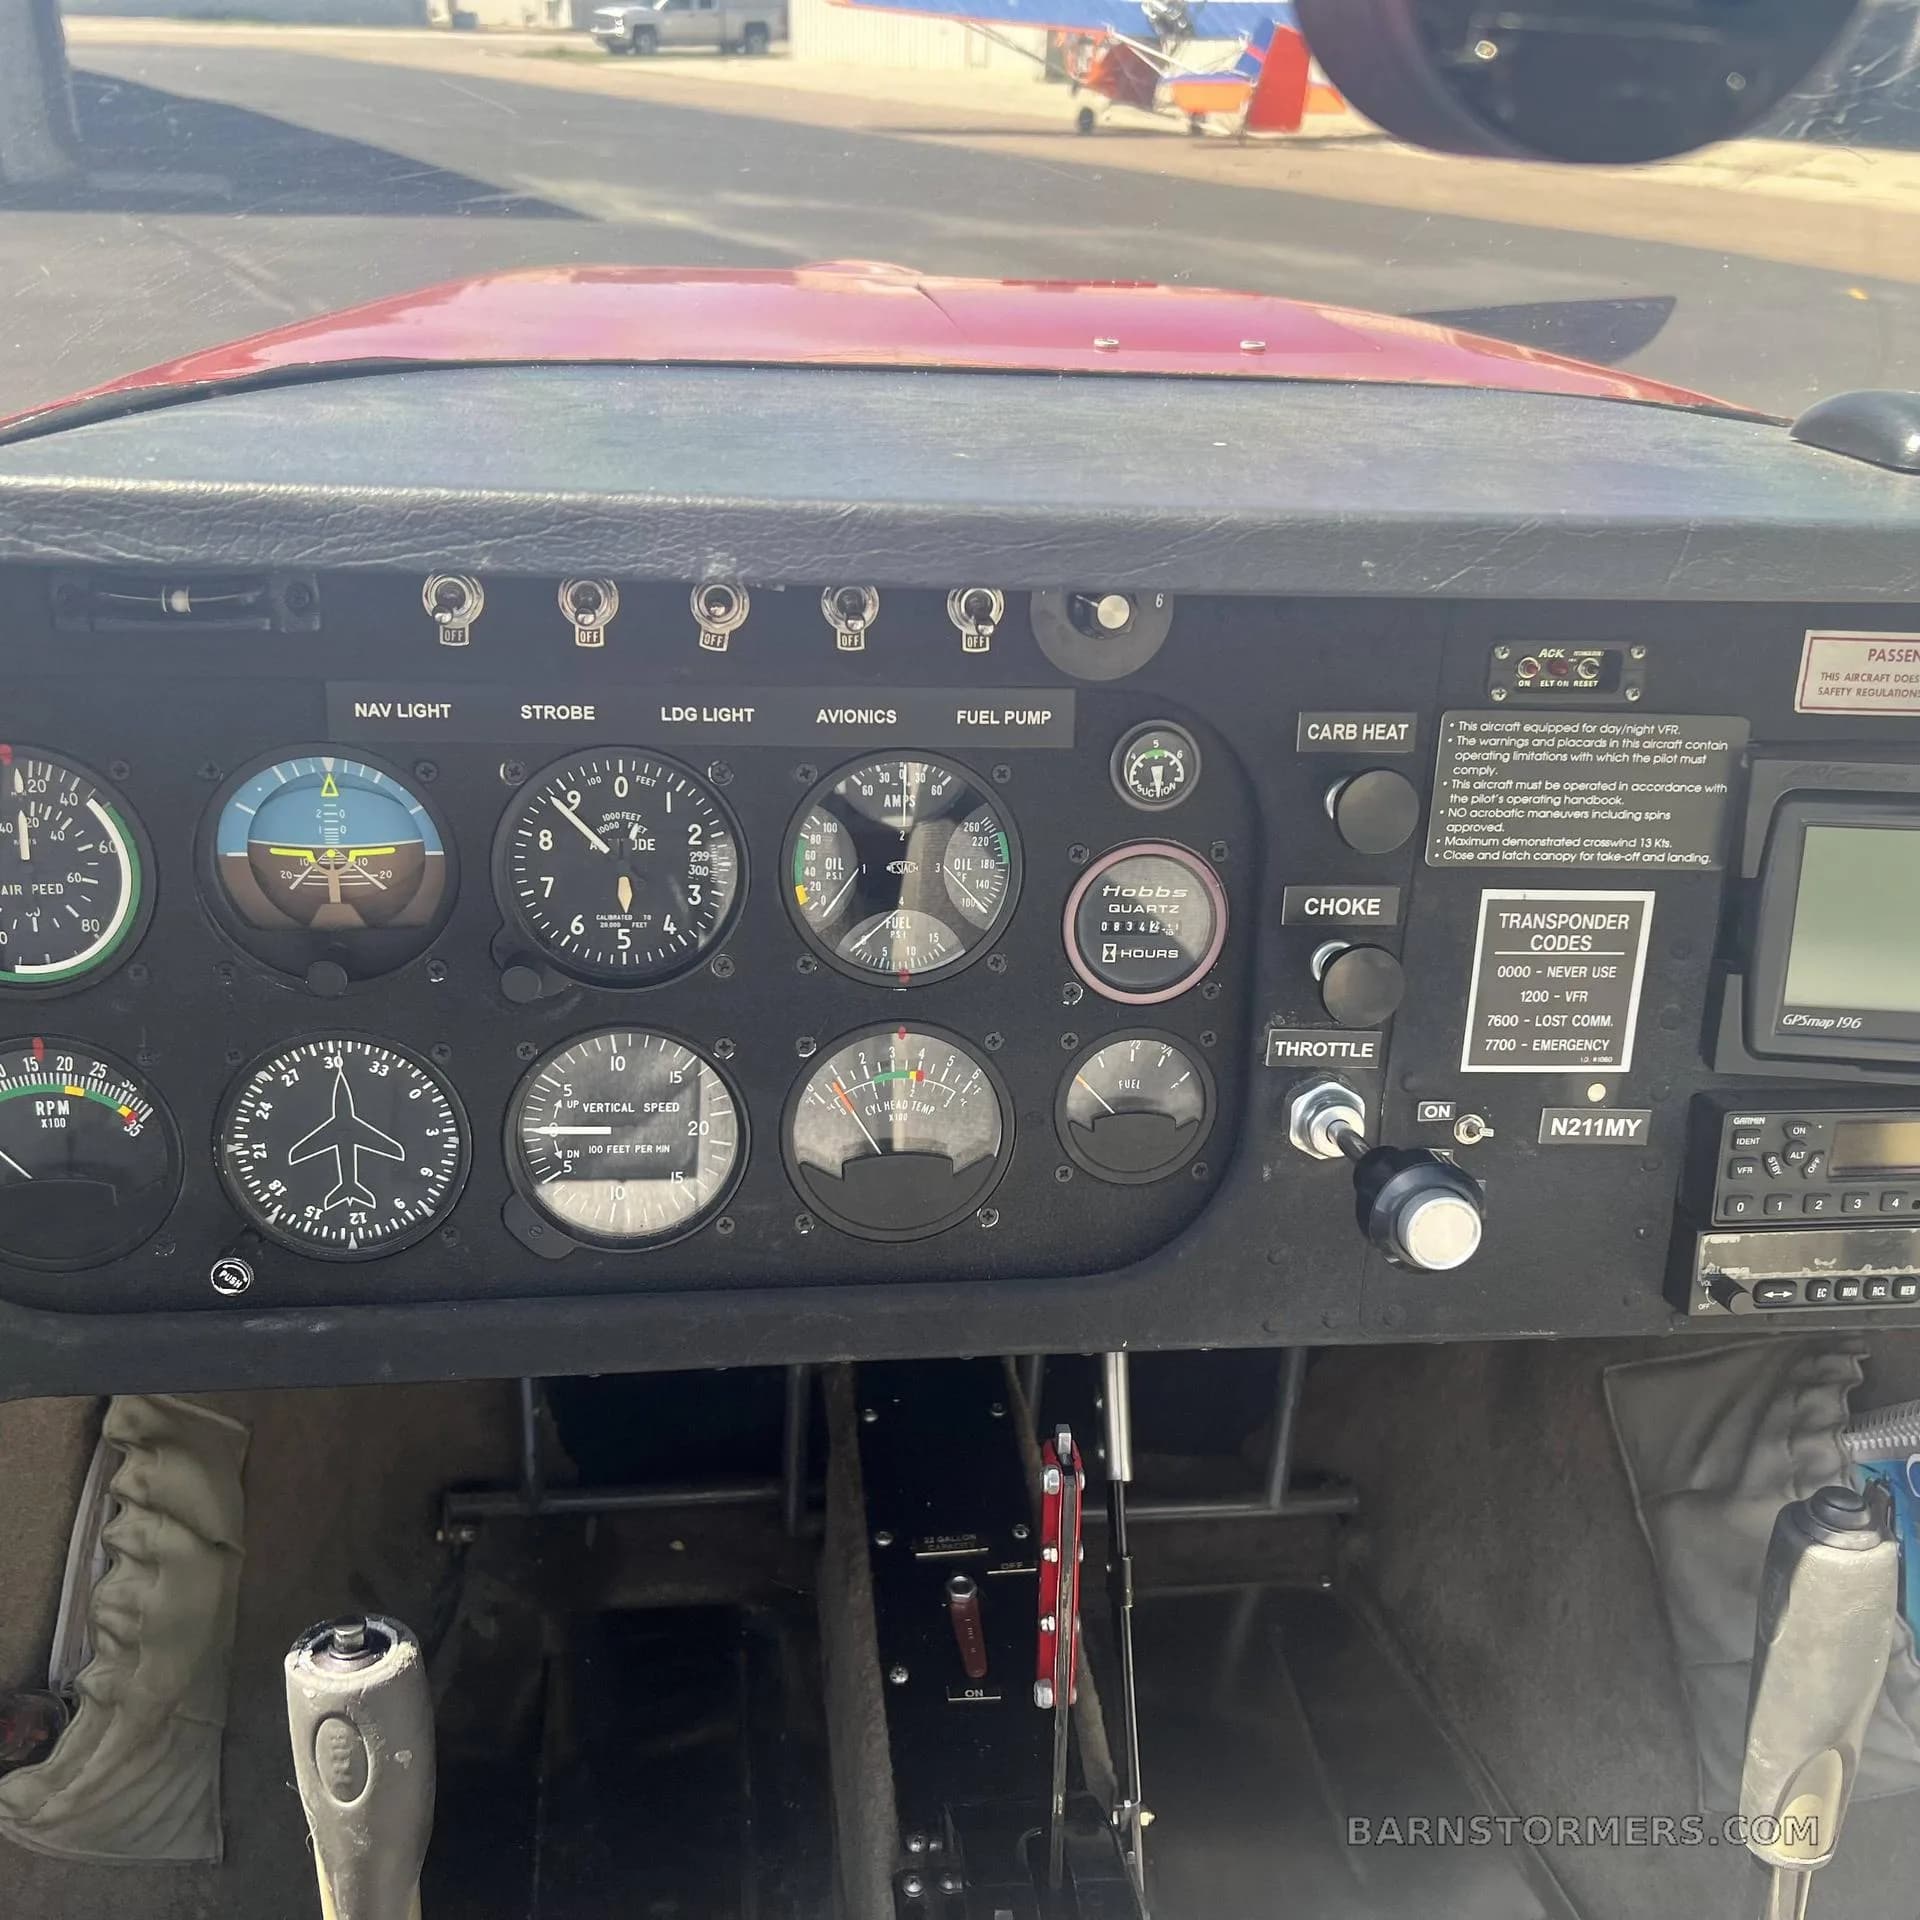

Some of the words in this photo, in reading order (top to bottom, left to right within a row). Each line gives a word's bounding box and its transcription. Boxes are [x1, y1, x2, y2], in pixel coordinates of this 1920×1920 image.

[443, 629, 465, 642] OFF
[579, 630, 600, 643] OFF
[703, 633, 724, 647] OFF
[841, 634, 860, 647] OFF
[967, 635, 985, 648] OFF
[1538, 648, 1565, 658] ACK
[1820, 672, 1840, 681] THIS
[1844, 673, 1890, 682] AIRCRAFT
[1894, 674, 1920, 683] DOES
[1818, 687, 1852, 696] SAFETY
[355, 703, 391, 717] NAV
[398, 703, 451, 718] LIGHT
[521, 705, 595, 720] STROBE
[661, 706, 697, 721] LDG
[703, 708, 754, 722] LIGHT
[816, 709, 897, 725] AVIONICS
[957, 710, 1000, 724] FUEL
[1004, 710, 1052, 725] PUMP
[1307, 723, 1358, 740] CARB
[1362, 723, 1409, 740] HEAT
[1458, 721, 1478, 731] This
[1480, 722, 1521, 732] aircraft
[1523, 722, 1579, 734] equipped
[1582, 723, 1597, 733] for
[1600, 723, 1655, 736] day/night
[1456, 735, 1476, 746] The
[1479, 737, 1529, 748] warnings
[1532, 737, 1555, 747] and
[1557, 738, 1607, 749] placards
[1609, 739, 1619, 748] in
[1622, 739, 1640, 748] this
[1642, 740, 1683, 750] aircraft
[1685, 741, 1728, 751] contain
[1455, 752, 1510, 763] operating
[1512, 751, 1568, 762] limitations
[1571, 752, 1593, 762] with
[1596, 753, 1629, 763] which
[1632, 753, 1650, 763] the
[1653, 753, 1678, 764] pilot
[1680, 755, 1707, 764] must
[1453, 765, 1498, 777] comply.
[587, 776, 602, 786] 100
[636, 775, 656, 787] FEET
[1452, 779, 1471, 790] This
[1473, 780, 1514, 790] aircraft
[1515, 781, 1542, 790] must
[1545, 781, 1561, 791] be
[1563, 781, 1616, 792] operated
[1619, 782, 1628, 791] in
[1631, 782, 1702, 793] accordance
[1705, 783, 1727, 793] with
[884, 795, 916, 807] AMPS
[1450, 794, 1468, 803] the
[1506, 795, 1561, 806] operating
[1563, 795, 1624, 805] handbook.
[621, 811, 642, 822] FEET
[1447, 808, 1467, 818] NO
[1470, 808, 1525, 818] acrobatic
[1527, 810, 1589, 819] maneuvers
[1592, 810, 1642, 821] including
[1644, 811, 1671, 821] spins
[964, 822, 980, 832] 260
[1446, 823, 1505, 833] approved.
[688, 824, 702, 845] 2
[1444, 837, 1499, 846] Maximum
[1501, 837, 1581, 847] demonstrated
[1583, 838, 1637, 848] crosswind
[1640, 838, 1652, 848] 13
[825, 858, 844, 870] OIL
[1443, 850, 1474, 860] Close
[1477, 851, 1500, 860] and
[1502, 851, 1530, 861] latch
[1533, 852, 1577, 862] canopy
[1579, 852, 1594, 861] for
[1597, 852, 1640, 862] take-off
[1642, 852, 1665, 862] and
[1667, 853, 1712, 865] landing.
[954, 858, 972, 871] OIL
[1, 884, 23, 895] AIR
[31, 884, 64, 895] PEED
[1102, 885, 1189, 898] Hobbs
[1108, 904, 1180, 914] QUARTZ
[1304, 898, 1381, 915] CHOKE
[81, 919, 100, 932] 80
[885, 917, 911, 929] FUEL
[1499, 913, 1630, 930] TRANSPONDER
[617, 929, 631, 950] 5
[1530, 934, 1592, 951] CODES
[1120, 949, 1179, 958] HOURS
[1497, 965, 1531, 978] 0000
[1547, 966, 1588, 978] NEVER
[1592, 966, 1617, 978] USE
[1520, 990, 1549, 1003] 1200
[1565, 991, 1588, 1003] VFR
[1487, 1015, 1519, 1027] 7600
[1535, 1015, 1568, 1027] LOST
[1571, 1015, 1613, 1027] COMM.
[1782, 1014, 1834, 1029] GPSmap
[1837, 1017, 1863, 1030] 196
[1275, 1041, 1374, 1058] THROTTLE
[1485, 1039, 1516, 1051] 7700
[1532, 1039, 1610, 1051] EMERGENCY
[56, 1057, 73, 1072] 20
[89, 1061, 108, 1079] 25
[369, 1061, 389, 1077] 33
[610, 1056, 626, 1071] 10
[669, 1071, 683, 1083] 15
[1119, 1079, 1140, 1090] FUEL
[35, 1100, 70, 1116] RPM
[567, 1101, 579, 1109] UP
[583, 1103, 635, 1113] VERTICAL
[644, 1103, 680, 1112] SPEED
[865, 1103, 883, 1115] CYL
[884, 1100, 908, 1110] HEAD
[911, 1101, 936, 1115] TEMP
[1424, 1105, 1450, 1118] ON
[1550, 1117, 1642, 1137] N211MY
[1733, 1117, 1766, 1125] GARMIN
[688, 1121, 709, 1136] 20
[1793, 1127, 1806, 1135] ON
[1736, 1137, 1760, 1145] IDENT
[567, 1150, 580, 1159] DN
[588, 1146, 603, 1154] 100
[607, 1145, 630, 1153] FEET
[635, 1145, 652, 1153] PER
[656, 1145, 670, 1153] MIN
[1790, 1151, 1806, 1160] ALT
[1737, 1166, 1753, 1174] VFR
[1768, 1156, 1782, 1176] STBY
[1807, 1157, 1821, 1174] OFF
[219, 1270, 243, 1289] PUSH
[1816, 1288, 1827, 1298] EC
[1872, 1286, 1886, 1296] RCL
[965, 1689, 984, 1697] ON
